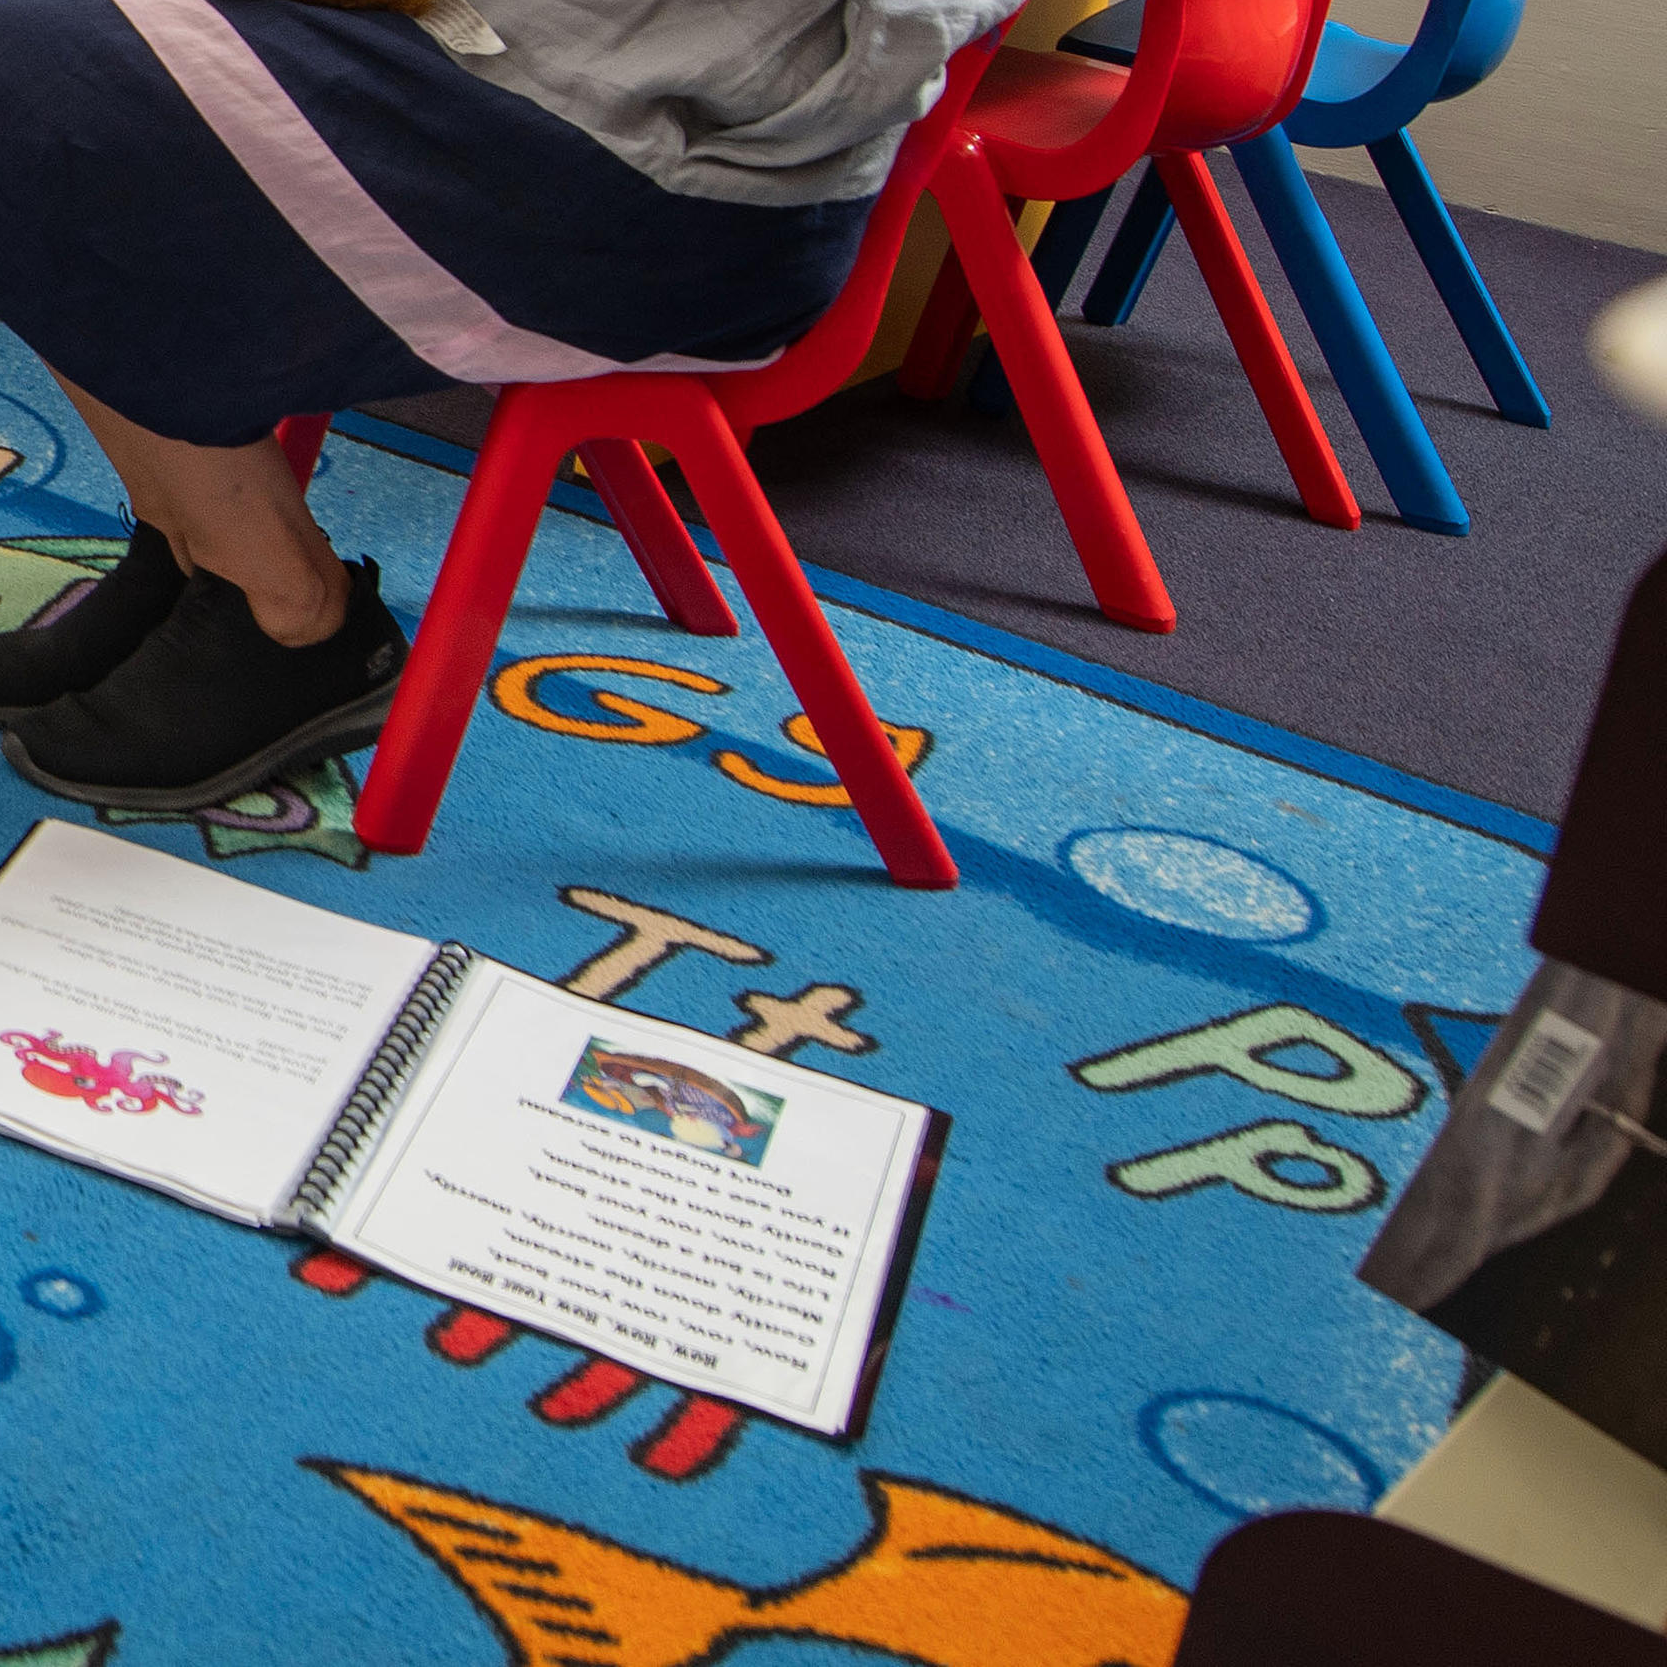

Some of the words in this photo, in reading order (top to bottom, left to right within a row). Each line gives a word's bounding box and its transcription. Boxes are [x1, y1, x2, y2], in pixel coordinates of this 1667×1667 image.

[591, 1216, 670, 1247] dream.
[505, 1229, 594, 1269] stream,
[679, 1246, 692, 1254] a
[448, 1258, 494, 1284] Boat
[489, 1248, 548, 1278] boat,
[702, 1253, 742, 1273] but
[752, 1270, 772, 1282] is
[503, 1278, 545, 1304] Your
[560, 1277, 610, 1301] your
[604, 1269, 643, 1288] the
[782, 1279, 829, 1301] Life
[556, 1298, 598, 1325] Row
[623, 1301, 667, 1321] row
[653, 1286, 721, 1314] down
[607, 1317, 657, 1348] Row,
[679, 1319, 732, 1344] row,
[732, 1311, 814, 1345] Gently
[666, 1340, 717, 1369] Row,
[745, 1339, 807, 1370] Row,
